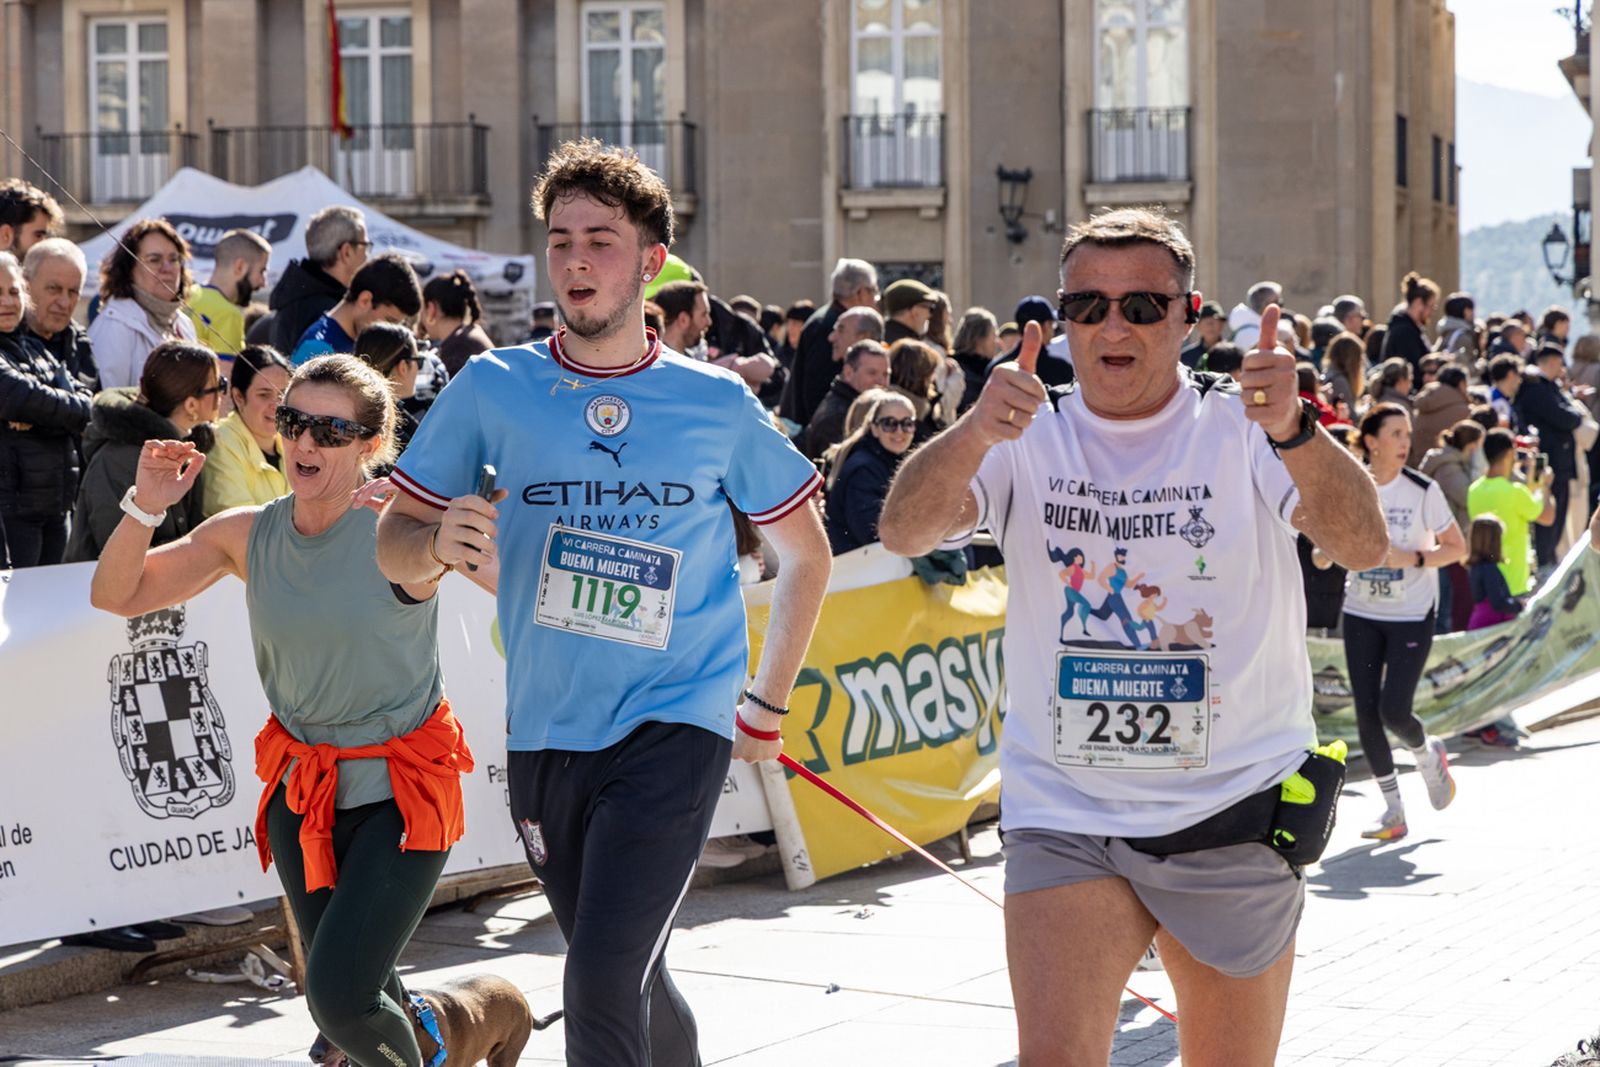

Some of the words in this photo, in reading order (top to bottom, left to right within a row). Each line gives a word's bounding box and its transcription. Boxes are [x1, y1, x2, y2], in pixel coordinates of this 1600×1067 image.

[590, 397, 626, 410] MANCHESTER
[521, 480, 695, 507] ETIHAD
[1049, 476, 1064, 492] VI
[1132, 484, 1213, 504] CAMINATA
[555, 514, 660, 530] AIRWAYS
[1044, 502, 1102, 535] BUENA
[1105, 512, 1176, 541] MUERTE
[574, 539, 615, 556] CARRERA
[618, 548, 661, 565] CAMINATA
[560, 551, 594, 571] BUENA
[597, 558, 641, 581] MUERTE
[571, 574, 642, 619] 1119
[1369, 581, 1391, 596] 515
[1072, 662, 1083, 673] VI
[1084, 662, 1131, 674] CARRERA
[1133, 663, 1189, 675] CAMINATA
[837, 629, 1006, 765] masy
[1072, 678, 1109, 696] BUENA
[1113, 680, 1164, 697] MUERTE
[1086, 702, 1172, 745] 232
[11, 823, 33, 846] de
[109, 836, 193, 871] CIUDAD
[196, 830, 227, 856] DE
[232, 826, 258, 850] JA
